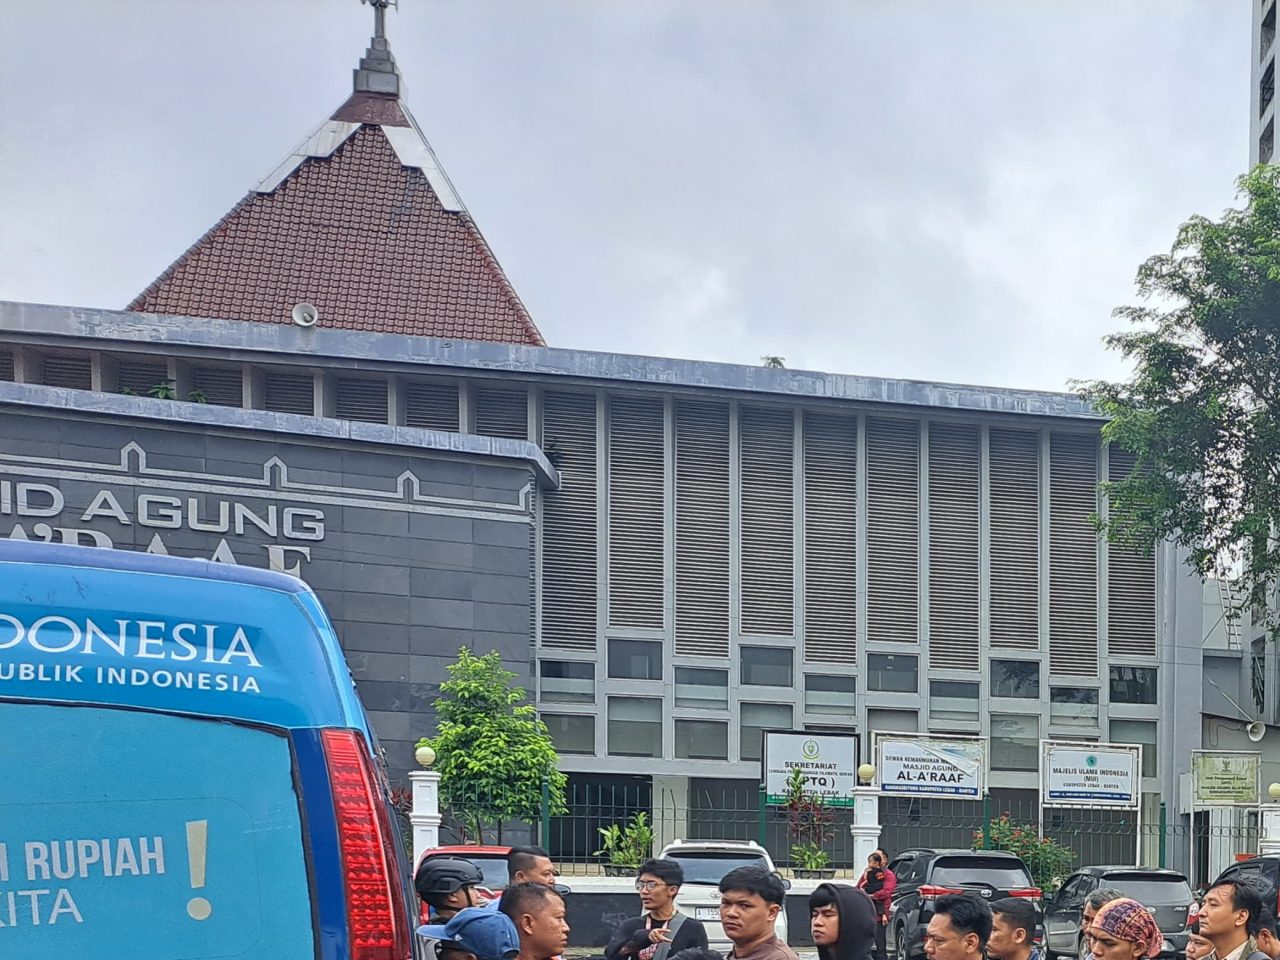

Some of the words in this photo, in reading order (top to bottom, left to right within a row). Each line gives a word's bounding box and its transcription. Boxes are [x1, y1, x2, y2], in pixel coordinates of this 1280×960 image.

[80, 489, 325, 540] AGUNG
[96, 666, 261, 693] INDONESIA
[784, 761, 838, 770] SEKRETARIAT
[902, 763, 931, 771] MASJID
[1052, 767, 1077, 775] MAJELIS
[1099, 769, 1129, 777] INDONESIA
[896, 770, 965, 783] AL-A'RAAF
[25, 836, 165, 881] RUPIAH
[0, 888, 84, 927] ITA
